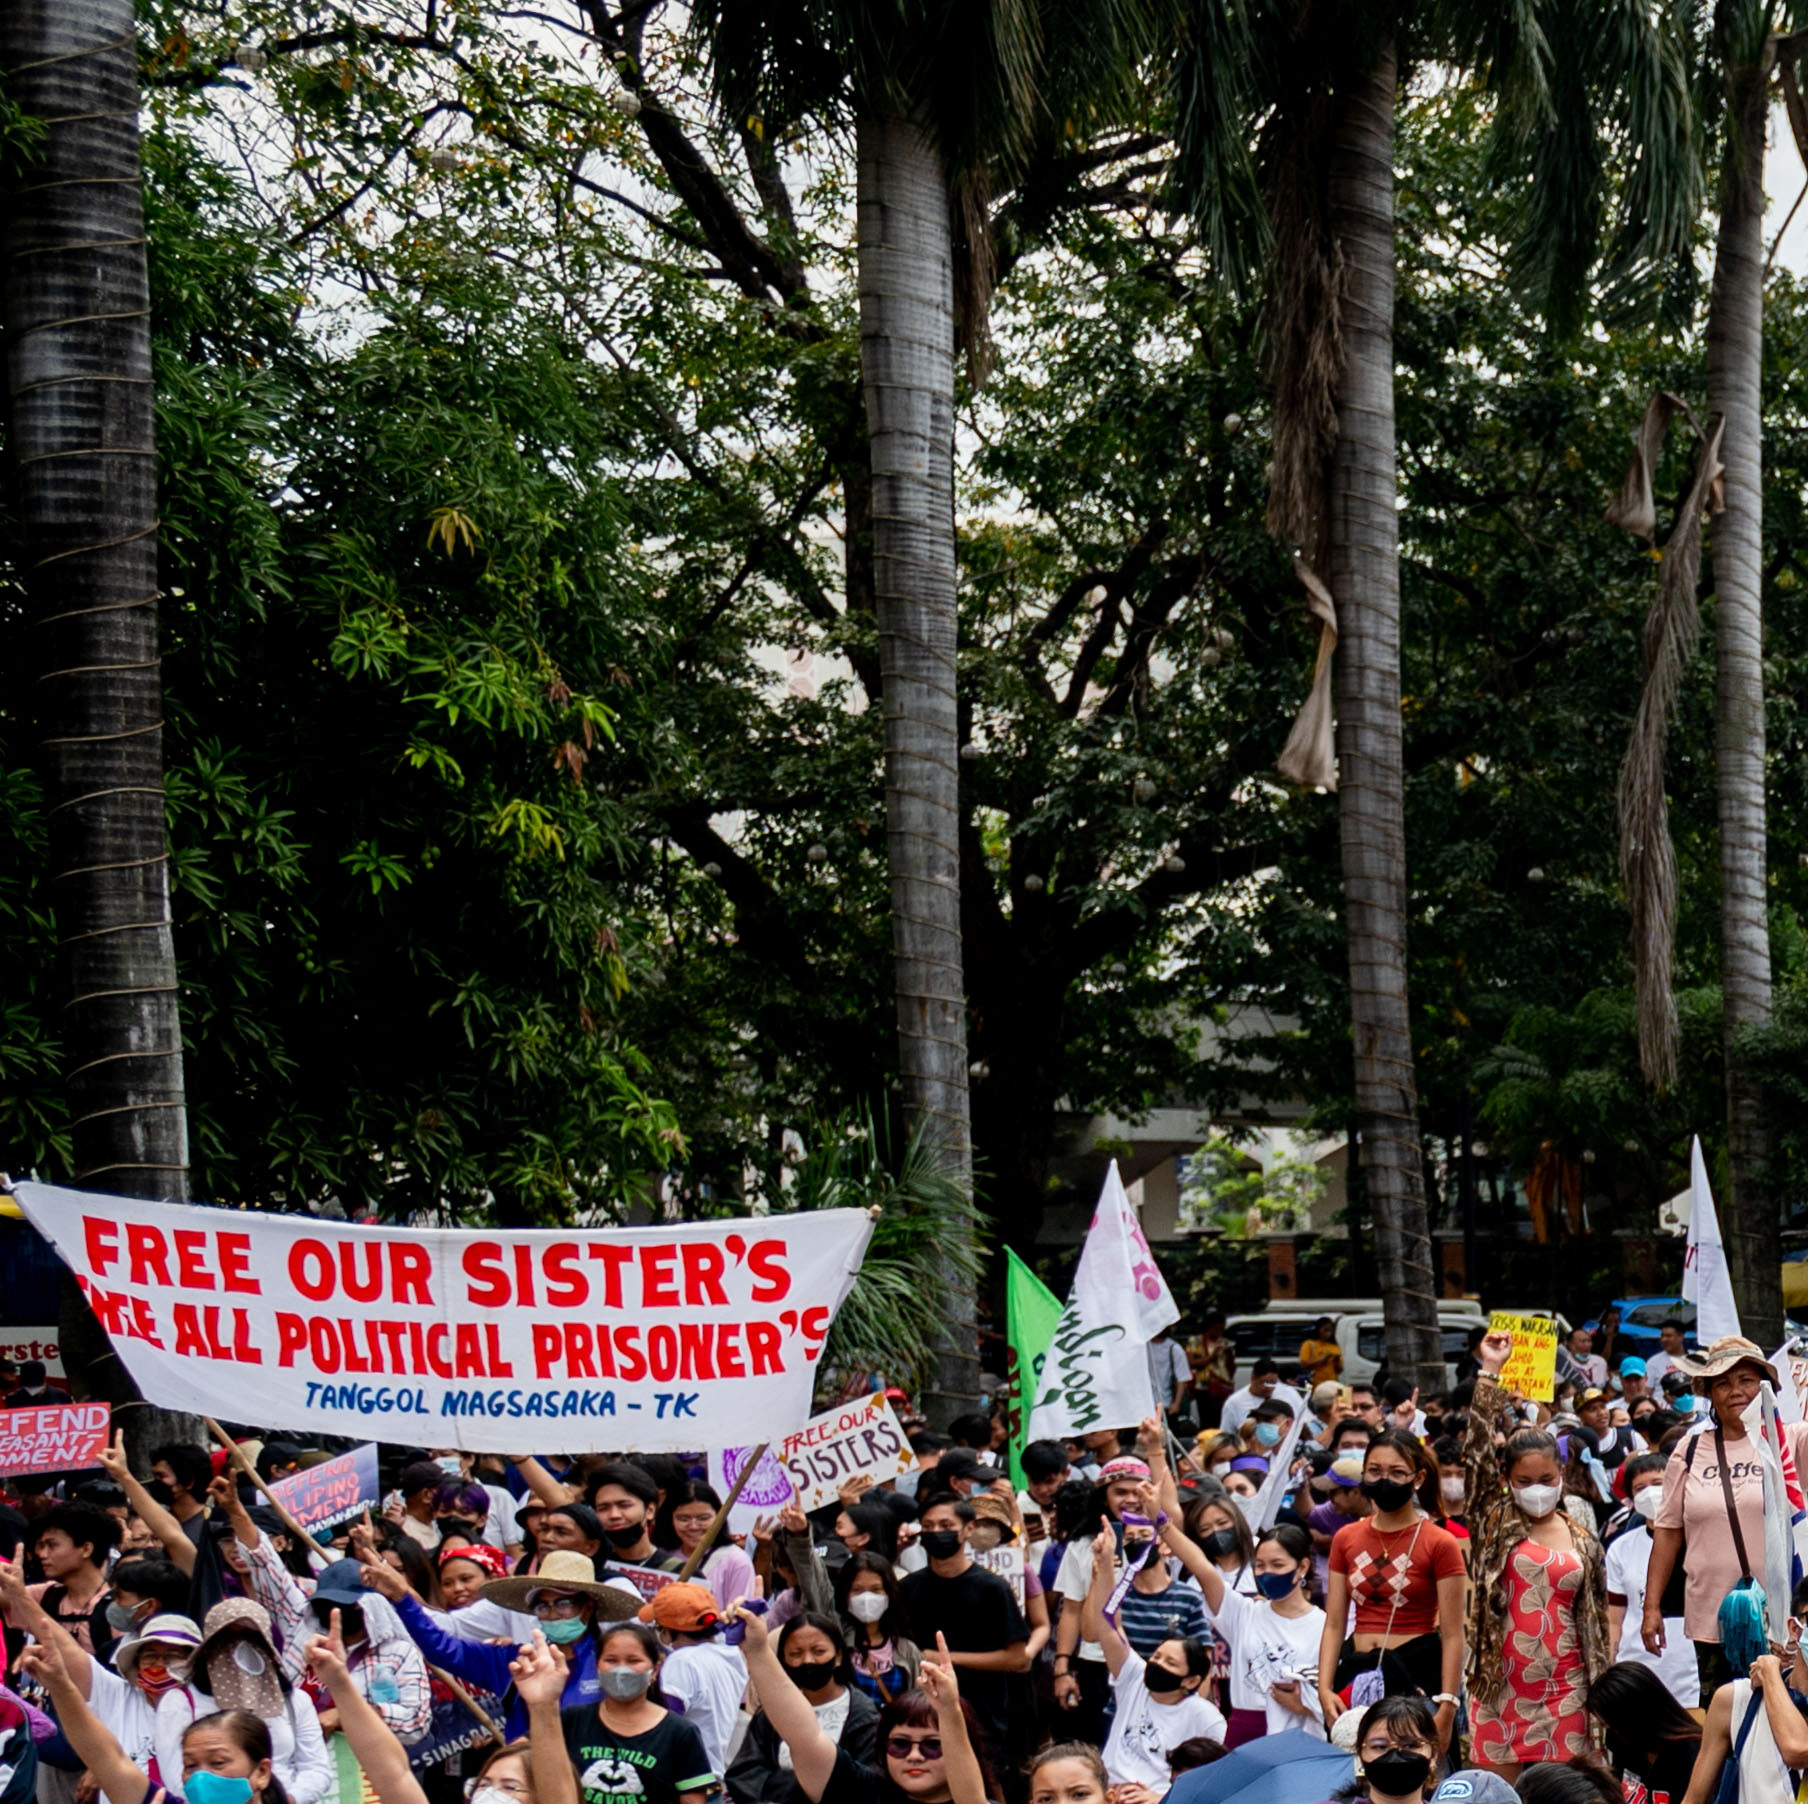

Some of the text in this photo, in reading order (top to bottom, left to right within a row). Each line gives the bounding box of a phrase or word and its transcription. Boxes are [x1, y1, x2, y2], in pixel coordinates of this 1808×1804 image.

[82, 1215, 792, 1309] FREE OUR SISTER'S
[173, 1302, 829, 1382] ALL POLITICAL PRISONER'S
[305, 1381, 700, 1419] TANGGOL MAGSASAKA TK
[782, 1405, 878, 1457] FREE OUR
[787, 1420, 902, 1492] SISTERS
[580, 1746, 657, 1769] THE WILD
